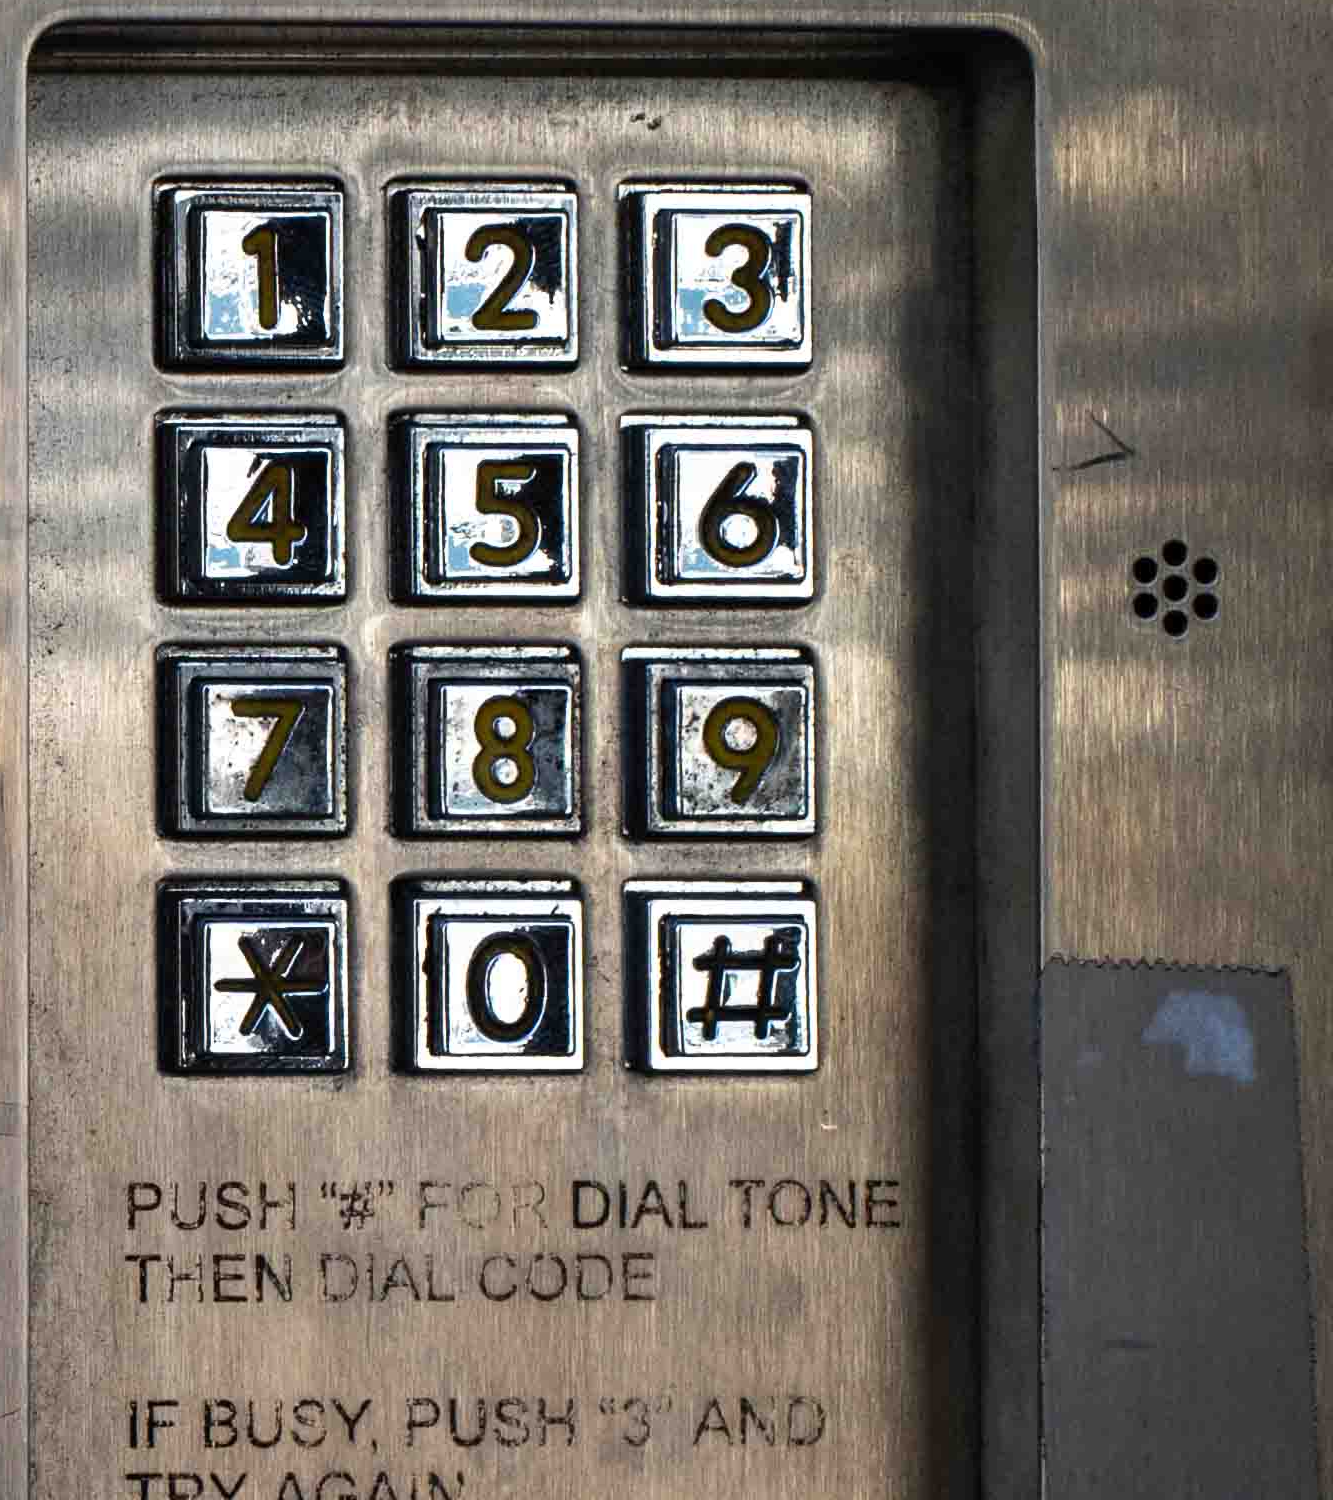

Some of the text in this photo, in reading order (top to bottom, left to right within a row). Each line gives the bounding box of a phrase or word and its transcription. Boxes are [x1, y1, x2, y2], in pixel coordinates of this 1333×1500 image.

[240, 222, 773, 334] 1 2 3
[227, 460, 781, 568] 4 5 6
[229, 699, 780, 804] 7 8 9
[126, 1180, 295, 1230] PUSH
[417, 1179, 548, 1230] FOR
[571, 1179, 709, 1230] DIAL
[729, 1179, 902, 1230] TONE
[124, 1252, 656, 1303] THEN DIAL CODE
[129, 1398, 179, 1449] IF
[202, 1398, 378, 1454] BUSY,
[406, 1398, 576, 1448] PUSH
[692, 1396, 827, 1447] AND
